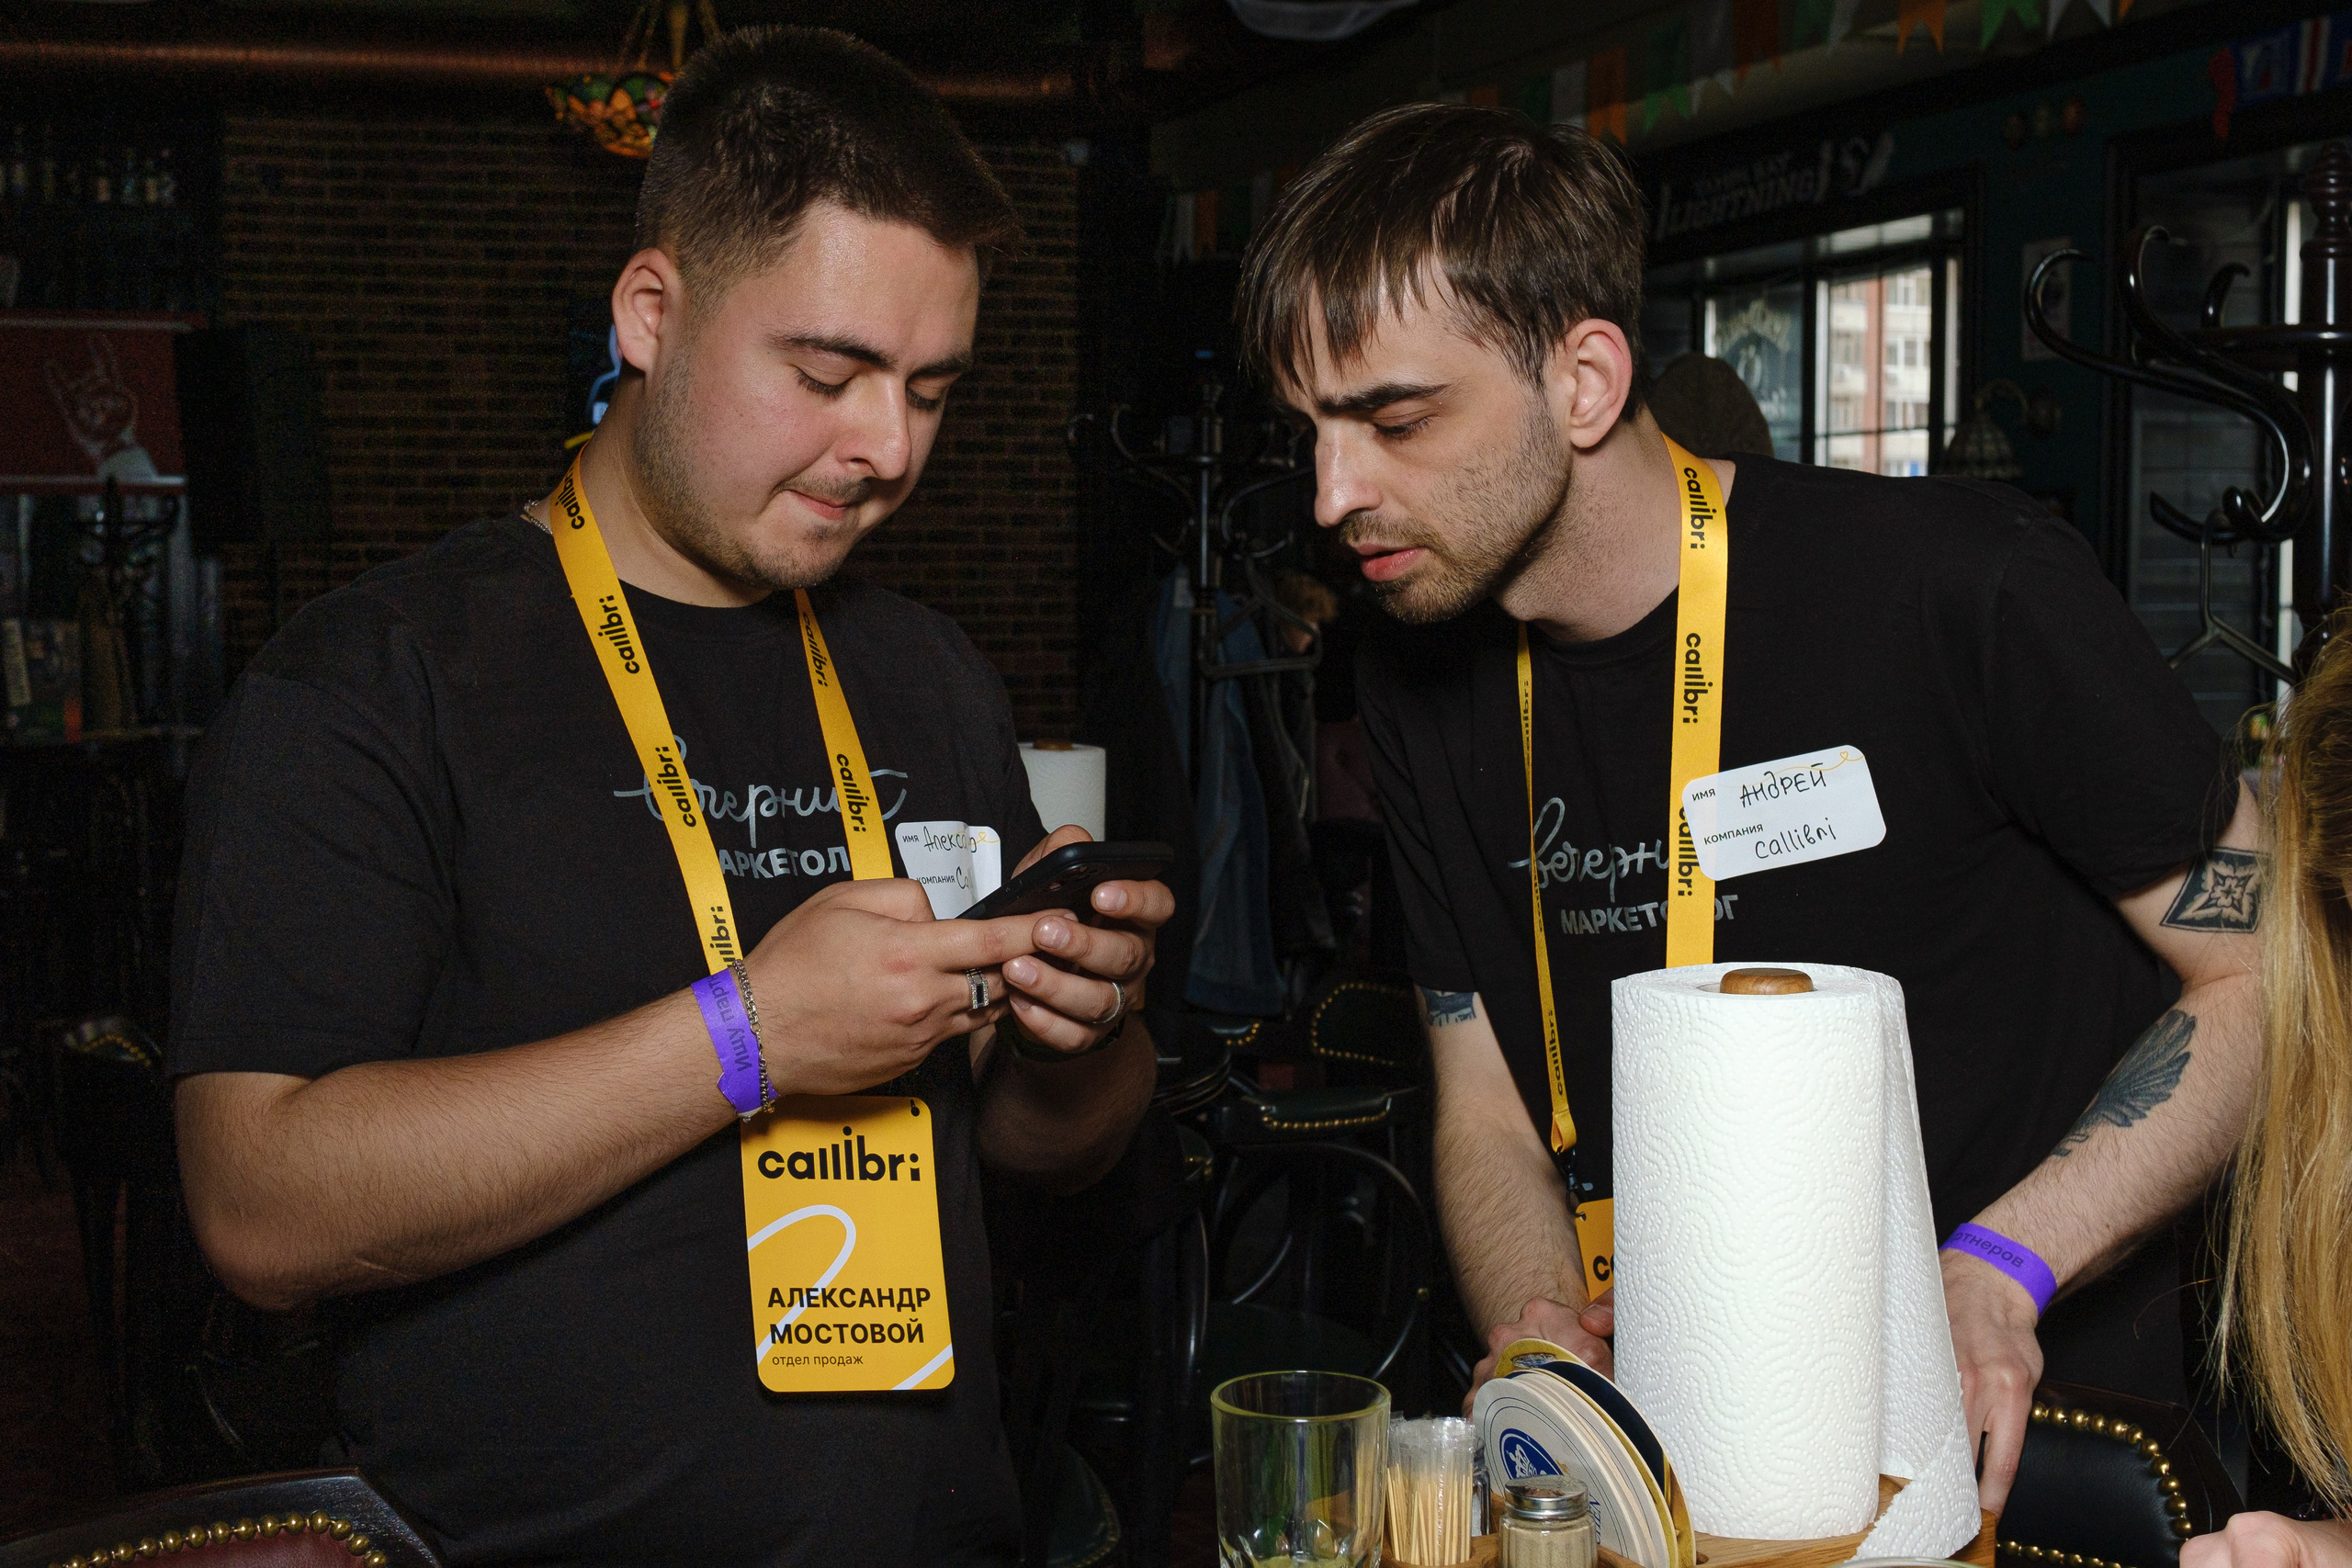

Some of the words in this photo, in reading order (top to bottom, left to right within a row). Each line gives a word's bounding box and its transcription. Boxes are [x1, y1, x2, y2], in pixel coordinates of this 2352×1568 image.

[1683, 467, 1717, 549] callibri
[598, 594, 640, 674] callibri
[801, 611, 828, 687] callibri
[1682, 632, 1713, 724] callibri
[654, 745, 697, 828] callibri
[836, 753, 870, 832] callibri
[1691, 788, 1715, 802] ИМЯ
[902, 834, 920, 843] ИМЯ
[1704, 824, 1764, 845] КОМПАНИЯ
[757, 1125, 921, 1182] callibri
[767, 1287, 931, 1311] АЛЕКСАНДР
[770, 1318, 924, 1345] МОСТОВОЙ
[772, 1354, 809, 1366] отдел
[812, 1354, 864, 1366] продаж
